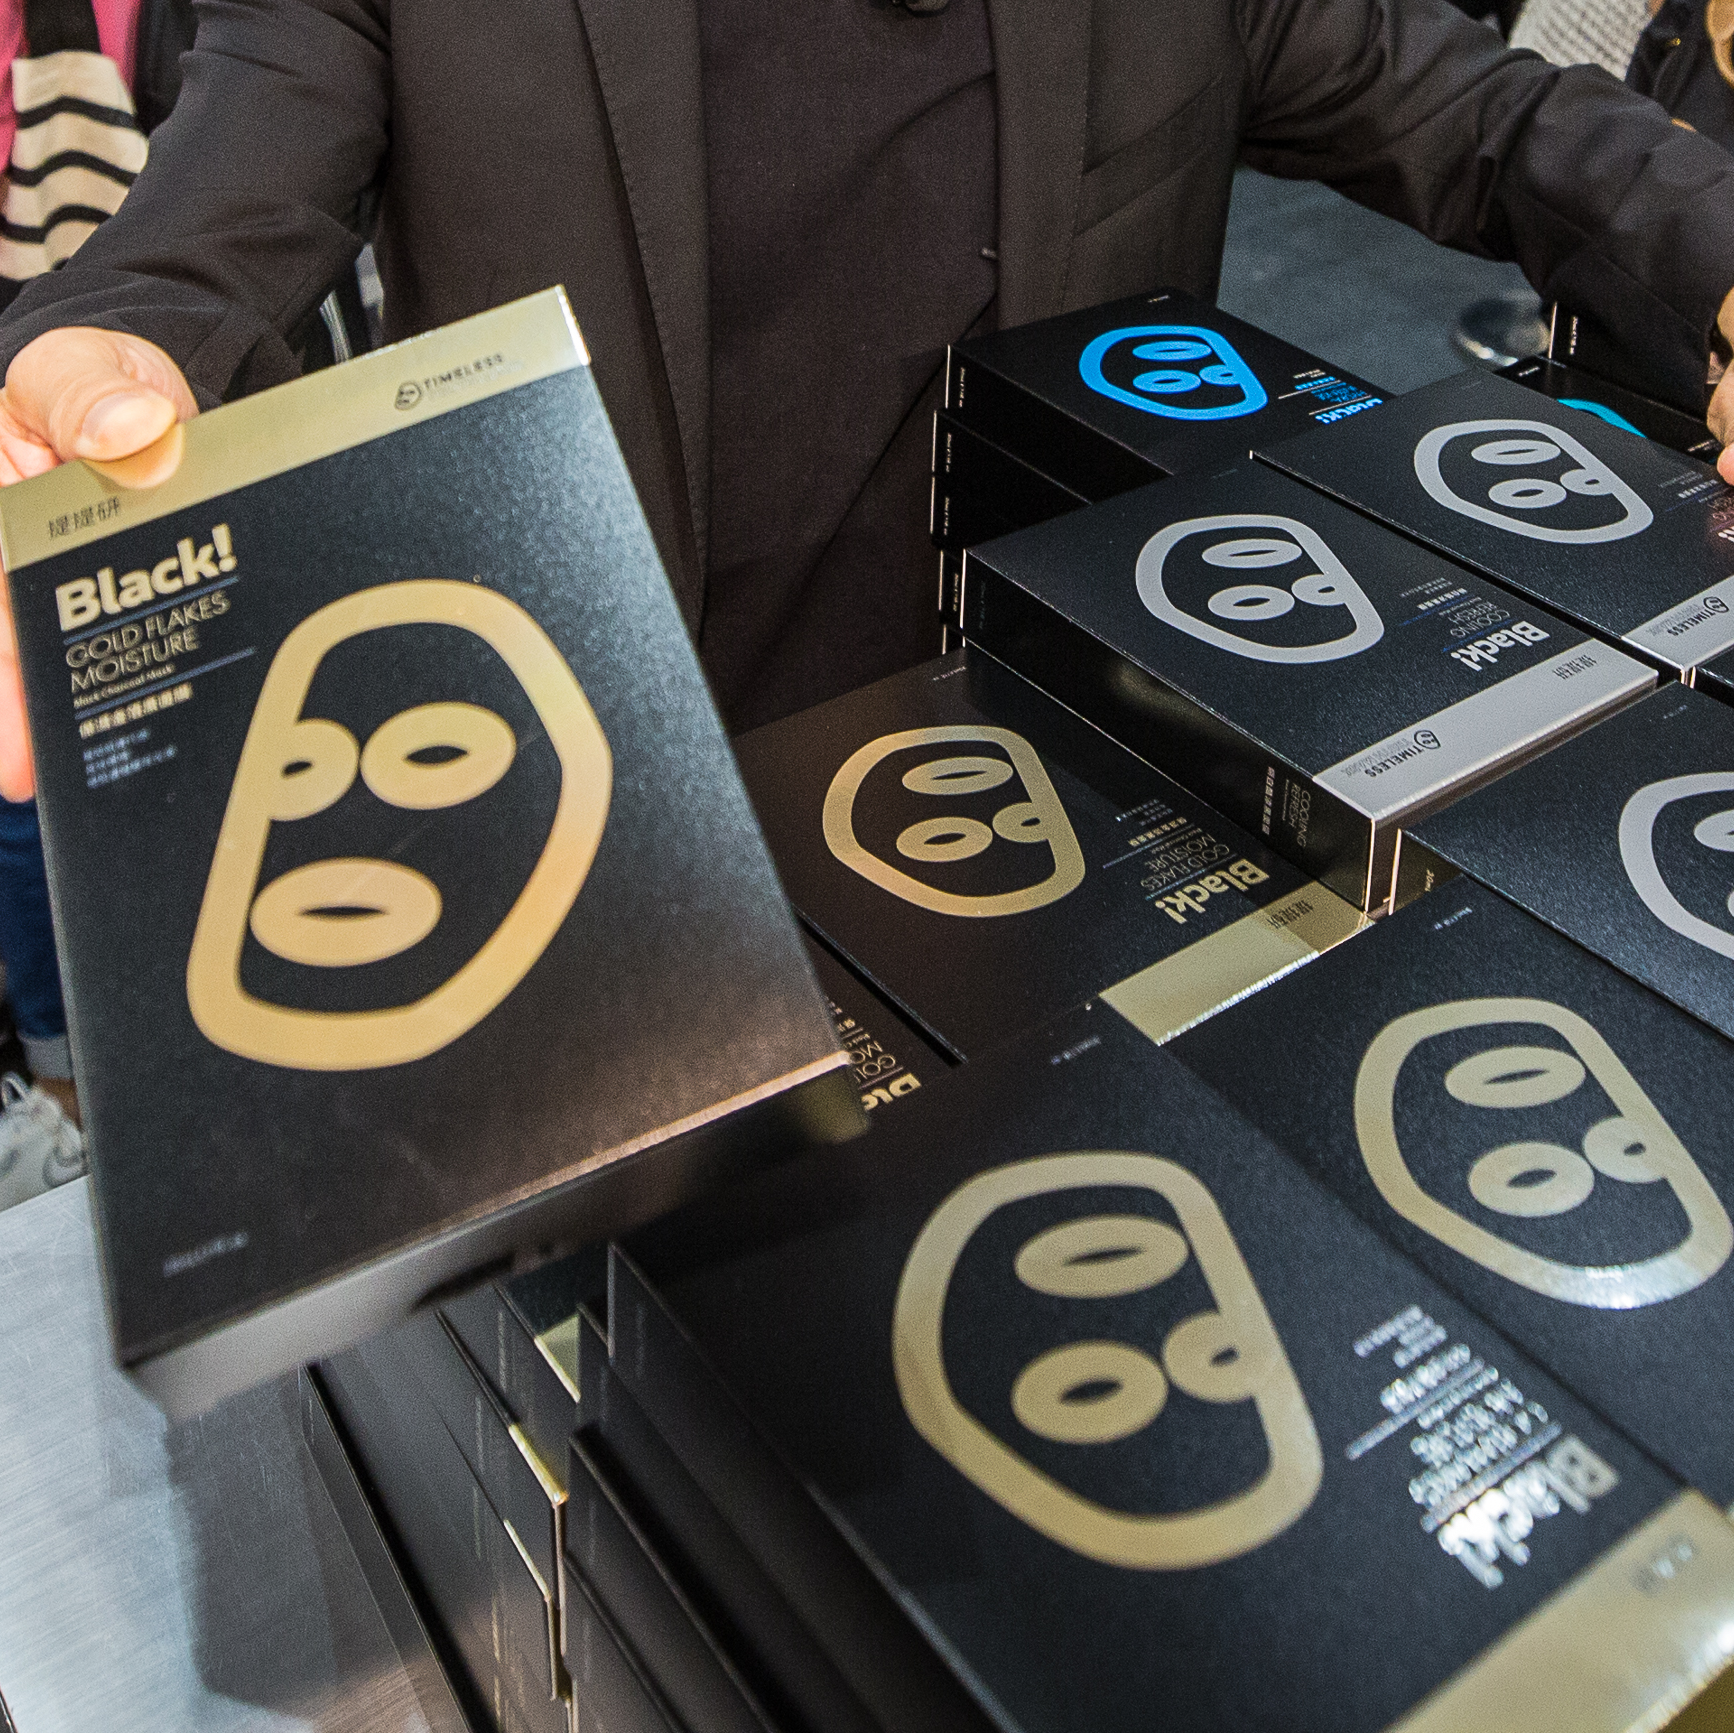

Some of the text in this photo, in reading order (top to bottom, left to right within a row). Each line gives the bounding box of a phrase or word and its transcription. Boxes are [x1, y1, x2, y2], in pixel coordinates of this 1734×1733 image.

[423, 352, 504, 391] TIMELESS
[55, 522, 238, 632] Black!
[65, 589, 233, 669] GOLD FLAKES
[1450, 620, 1552, 673] Black!
[1667, 607, 1717, 637] TIMELESS
[69, 625, 203, 695] MOISTURE
[1364, 743, 1425, 778] TIMELESS
[1288, 782, 1301, 829] REFRESH
[1296, 788, 1312, 848] COOLING
[1139, 843, 1231, 892] GOLD FLAKES
[1143, 832, 1217, 873] MOISTURE
[1154, 858, 1270, 925] Black!
[1437, 1432, 1619, 1590] Black!
